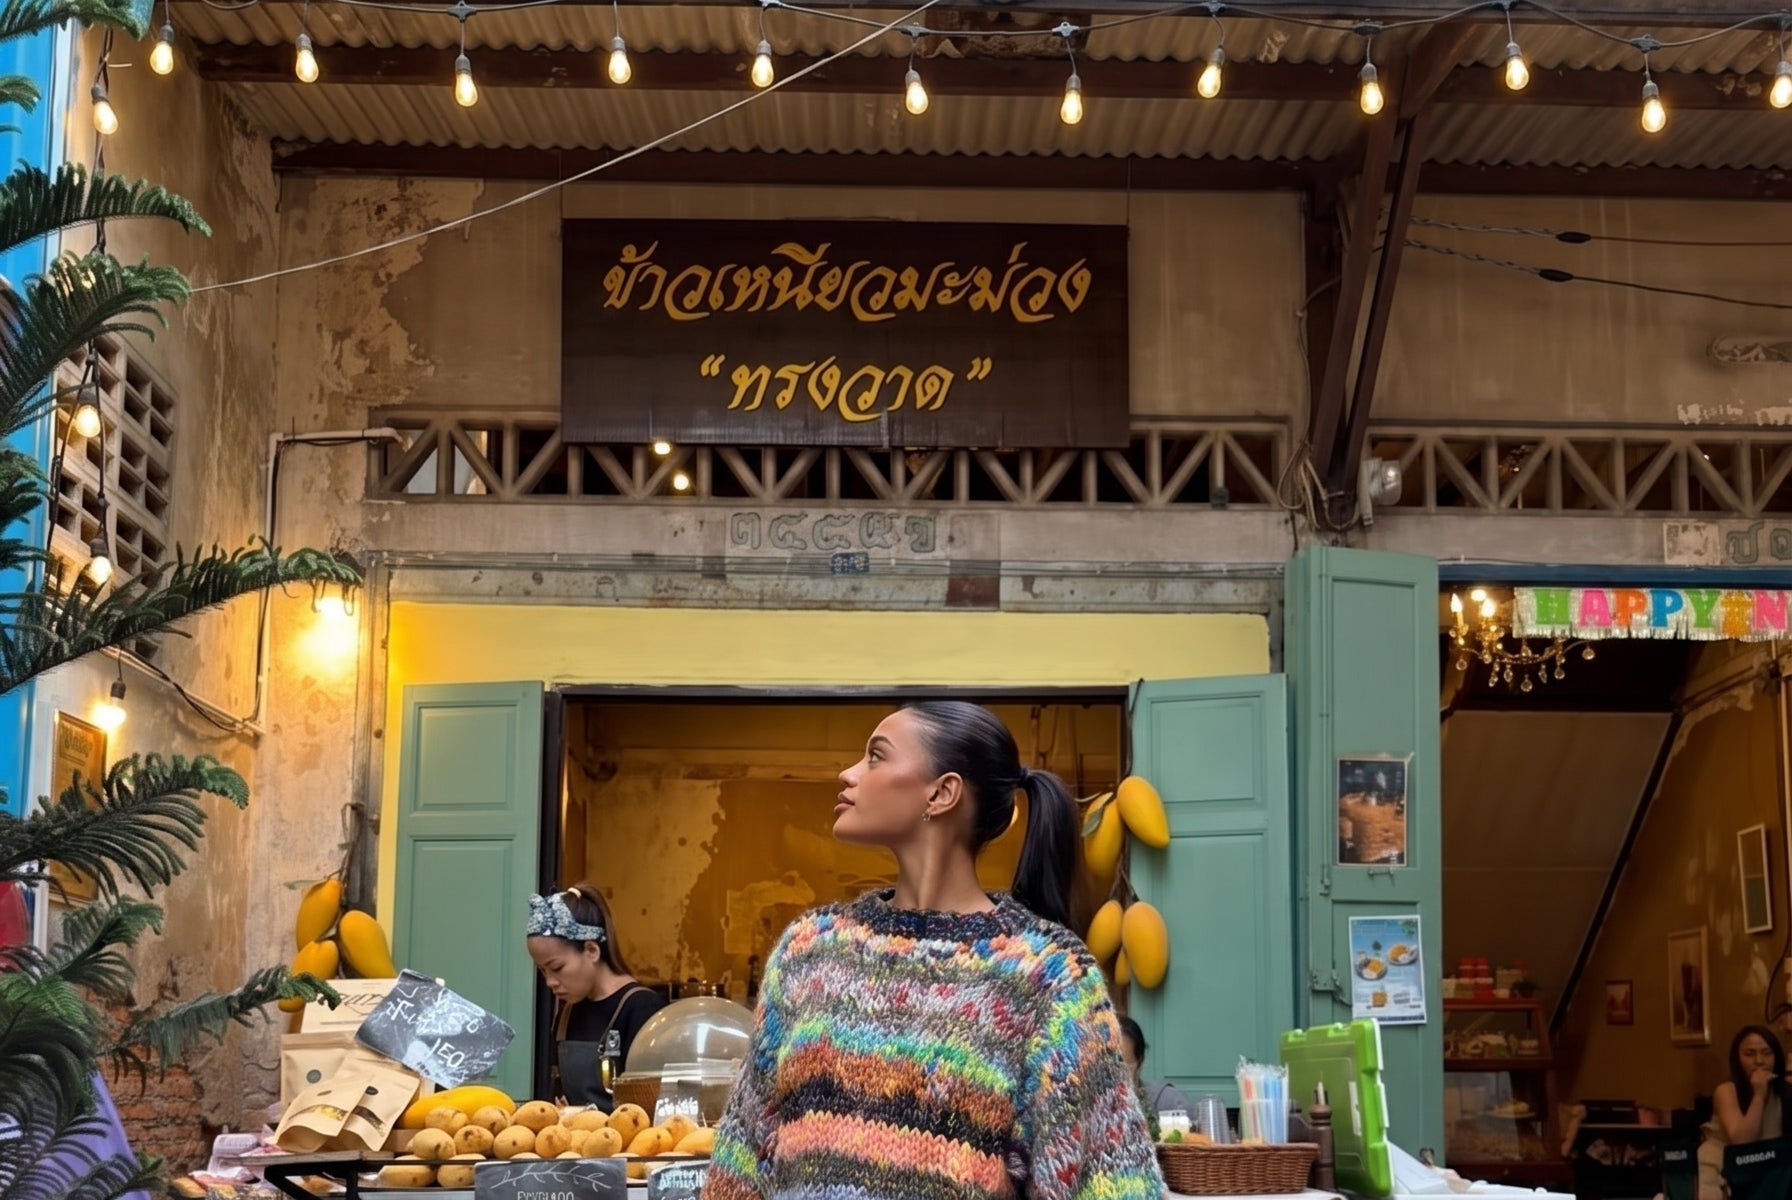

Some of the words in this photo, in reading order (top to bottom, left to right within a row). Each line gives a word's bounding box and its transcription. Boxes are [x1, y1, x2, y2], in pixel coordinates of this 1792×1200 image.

[602, 241, 1093, 323] ข้าวเหนียวมะม่วง
